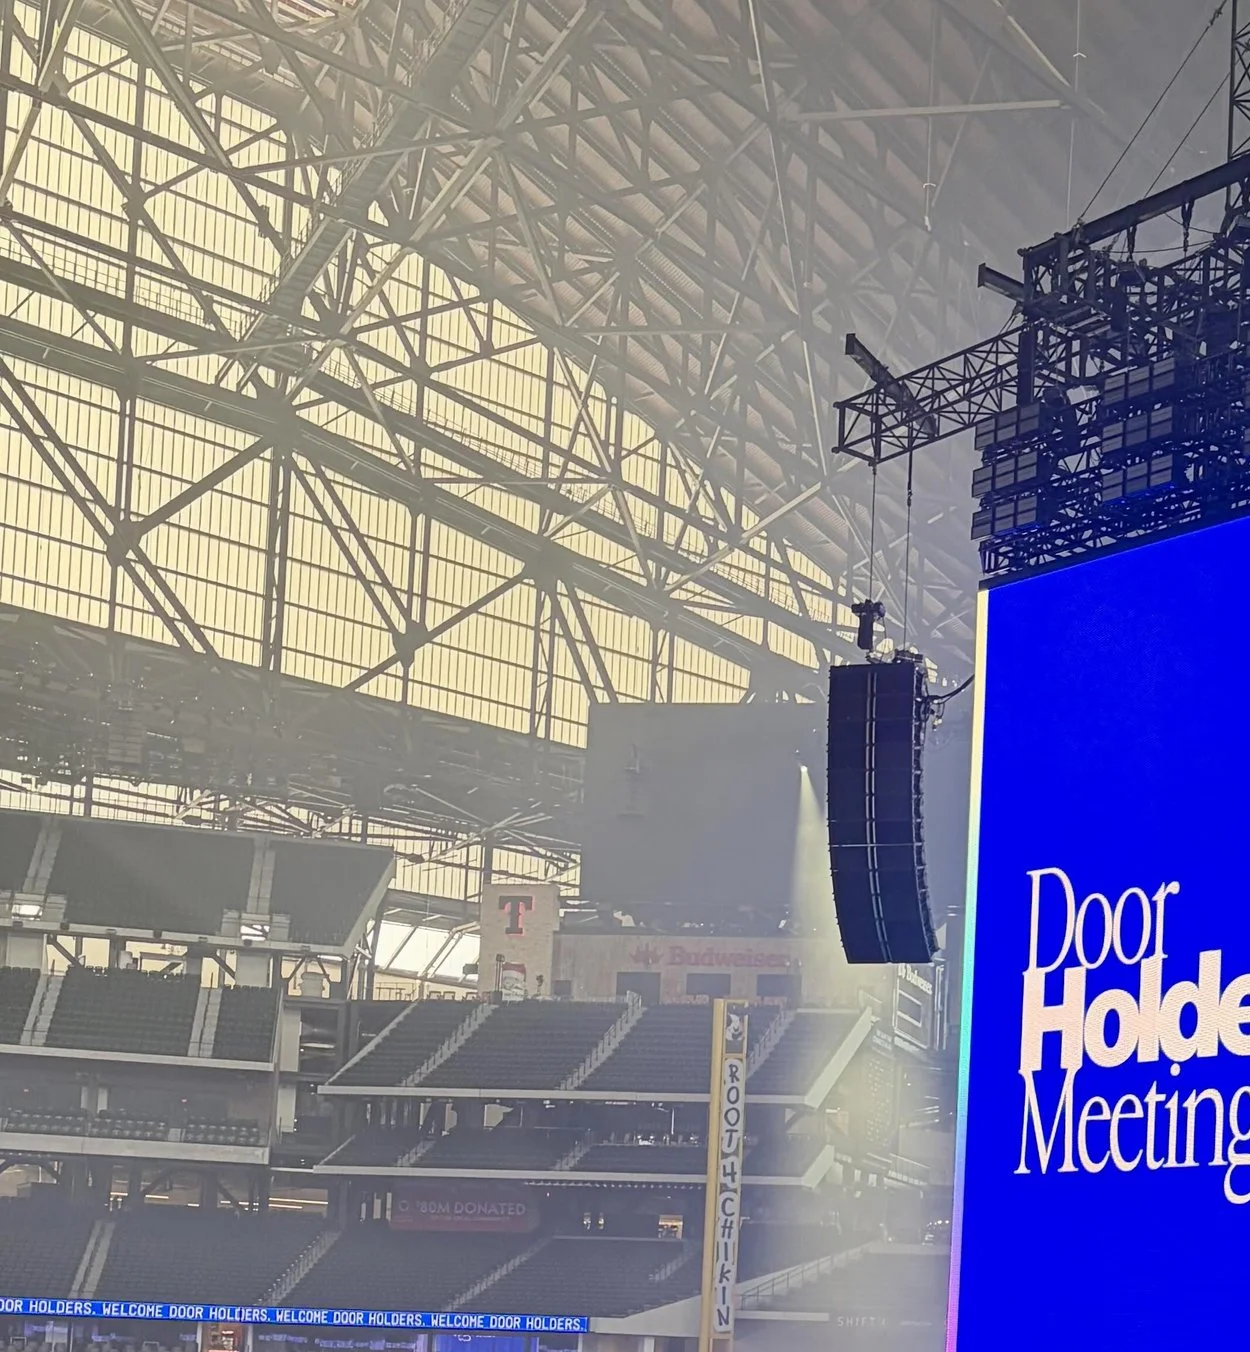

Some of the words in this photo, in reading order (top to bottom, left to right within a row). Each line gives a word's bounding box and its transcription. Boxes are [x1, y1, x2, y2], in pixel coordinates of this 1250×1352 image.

[497, 895, 533, 936] T
[1023, 867, 1180, 975] Door
[667, 945, 790, 968] Budweiser
[723, 1063, 740, 1149] ROOT
[722, 1161, 737, 1183] 4
[454, 1201, 526, 1216] DONATED
[29, 1300, 96, 1316] HOLDERS.
[102, 1302, 163, 1318] WELCOME
[169, 1305, 204, 1320] DOOR
[275, 1308, 328, 1324] WELCOME
[333, 1311, 363, 1326] DOOR
[368, 1312, 426, 1328] HOLDERS.
[431, 1314, 485, 1329] WELCOME
[489, 1315, 521, 1330] DOOR
[526, 1317, 584, 1331] HOLDERS.
